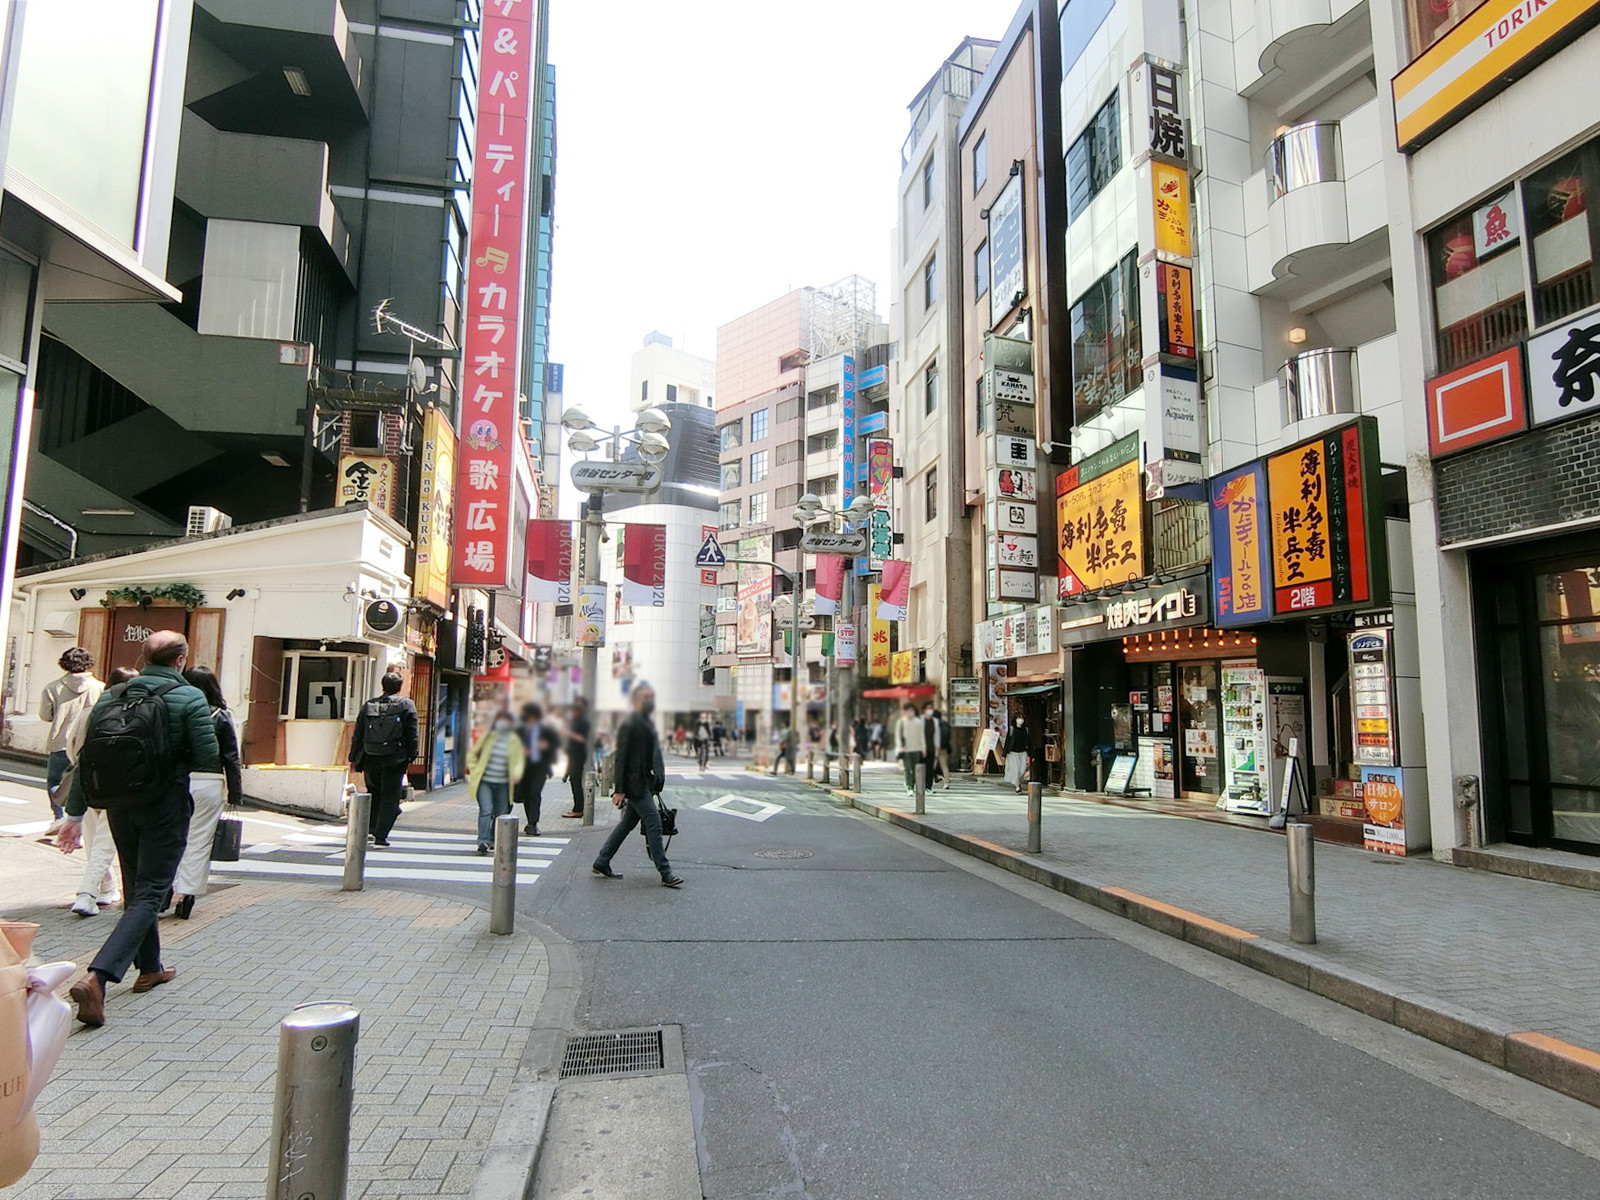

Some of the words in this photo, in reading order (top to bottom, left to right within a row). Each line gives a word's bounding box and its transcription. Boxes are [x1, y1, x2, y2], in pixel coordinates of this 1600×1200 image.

[1150, 68, 1185, 160] 日焼
[1485, 205, 1510, 248] 魚
[472, 282, 508, 413] カラオケ
[1165, 408, 1195, 421] Aquavit
[423, 441, 434, 472] KIN
[345, 461, 378, 506] 金の
[423, 479, 431, 493] no
[575, 467, 656, 481] 渋谷センター街
[419, 502, 430, 545] KURA
[464, 460, 499, 573] 歌広場
[653, 526, 665, 572] TOKYO
[806, 537, 862, 547] 渋谷センター街
[558, 570, 570, 603] 2020
[652, 577, 664, 607] 2020
[1290, 586, 1316, 609] 2階
[897, 597, 907, 622] 2020
[1367, 782, 1399, 798] 日焼け
[1368, 798, 1398, 812] サロン
